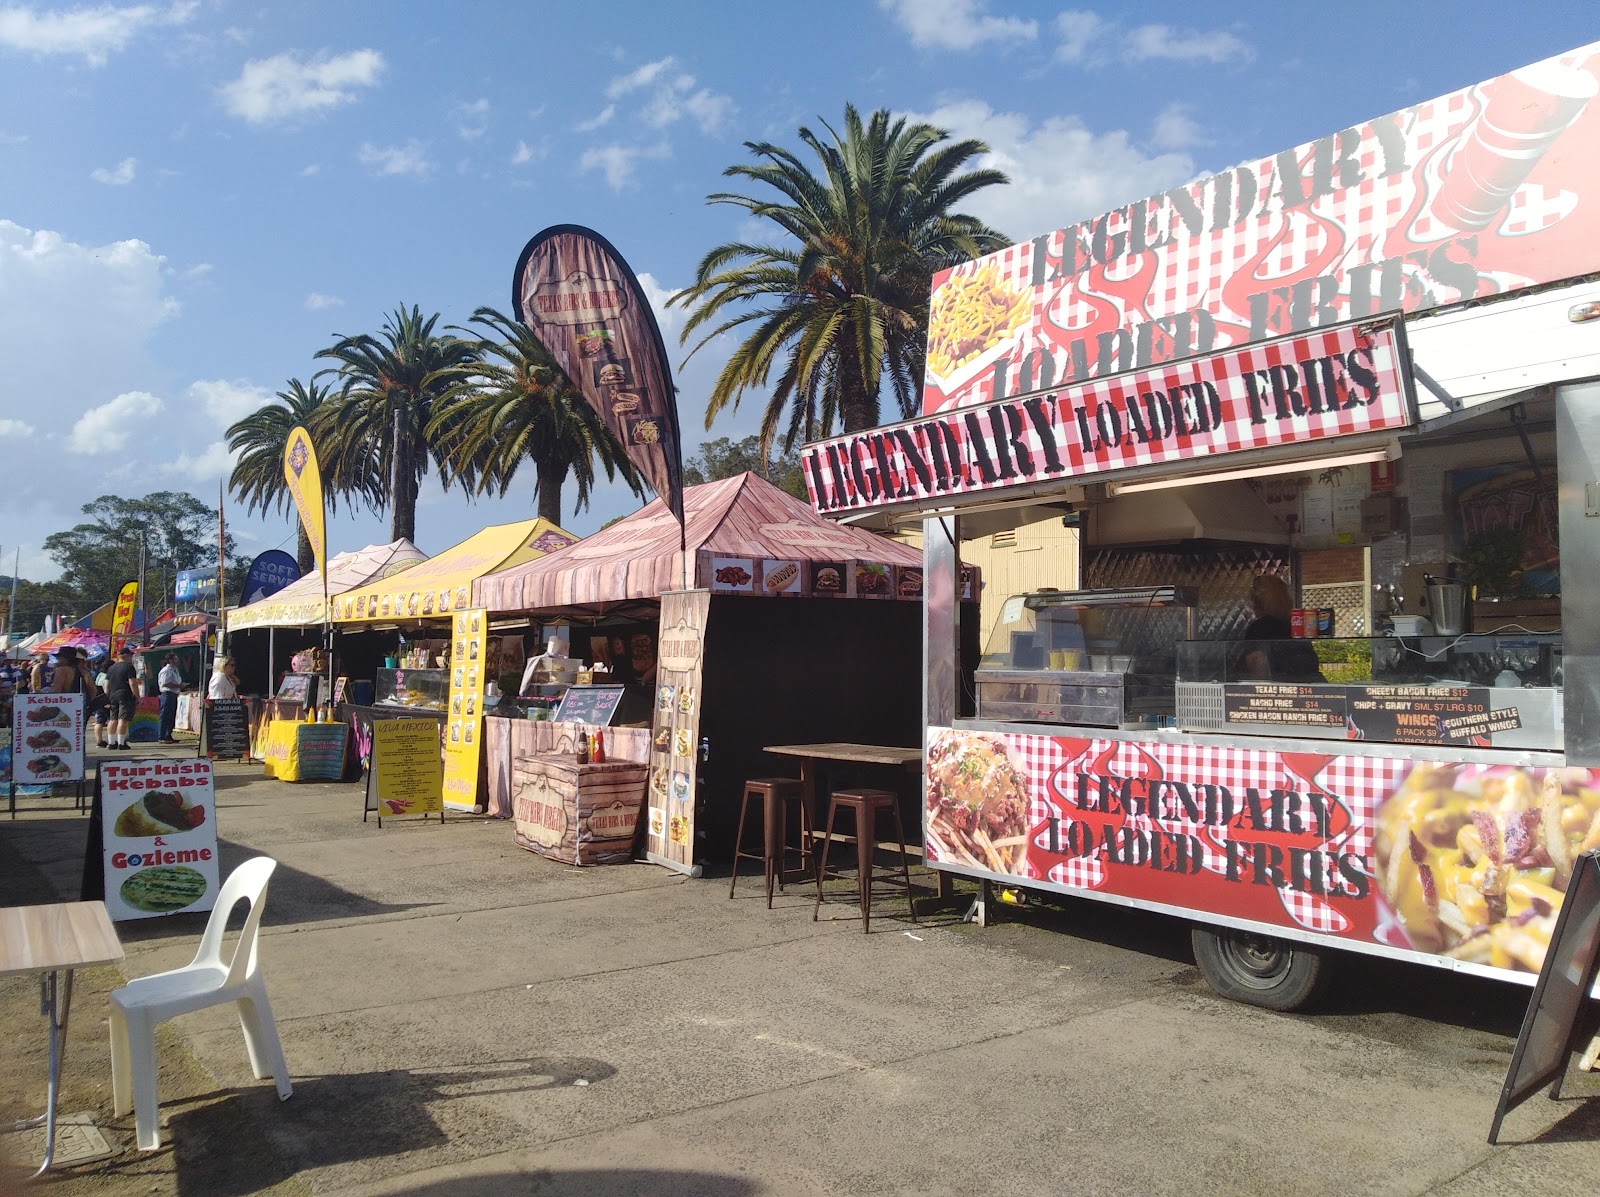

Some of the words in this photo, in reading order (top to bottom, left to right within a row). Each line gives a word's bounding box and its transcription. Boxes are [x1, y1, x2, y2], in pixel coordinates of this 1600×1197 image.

[1029, 106, 1422, 287] LEGENDARY
[537, 294, 562, 313] TEXAS
[992, 306, 1217, 401] LOADED
[1246, 234, 1480, 343] FRIES
[808, 394, 1066, 512] LEGENDARY
[1076, 380, 1222, 453] LOADED
[1243, 342, 1382, 425] FRIES
[258, 561, 294, 578] SOFT
[252, 570, 294, 586] SERVE
[1254, 686, 1278, 694] TEXAS
[1278, 686, 1298, 694] FRIES
[1366, 688, 1396, 696] CHEESY
[1398, 688, 1426, 696] BACON
[1428, 688, 1450, 696] FRIES
[1452, 689, 1468, 697] $12
[27, 696, 72, 704] Kebabs
[1250, 698, 1273, 707] NACHO
[1274, 700, 1294, 708] FRIES
[1354, 701, 1376, 710] CHIPS
[1385, 702, 1412, 710] GRAVY
[1414, 703, 1432, 711] SML
[1434, 703, 1444, 711] $7
[1446, 704, 1465, 712] LRG
[1467, 704, 1484, 712] $10
[1229, 711, 1257, 720] CHICKEN
[1258, 712, 1282, 720] BACON
[1283, 713, 1306, 721] RANCH
[1308, 713, 1328, 722] FRIES
[1396, 714, 1436, 726] WINGS
[1444, 713, 1488, 728] SOUTHERN
[1490, 708, 1518, 721] STYLE
[378, 723, 399, 733] VIVA
[401, 722, 436, 733] MEXICO
[1450, 727, 1487, 738] BUFFALO
[1489, 720, 1518, 732] WINGS
[104, 762, 210, 777] Turkish
[108, 777, 209, 790] Kebabs
[1073, 772, 1338, 838] LEGENDARY
[154, 837, 168, 846] &
[112, 848, 212, 869] Gozleme
[1046, 816, 1204, 876] LOADED
[1222, 841, 1371, 900] FRIES
